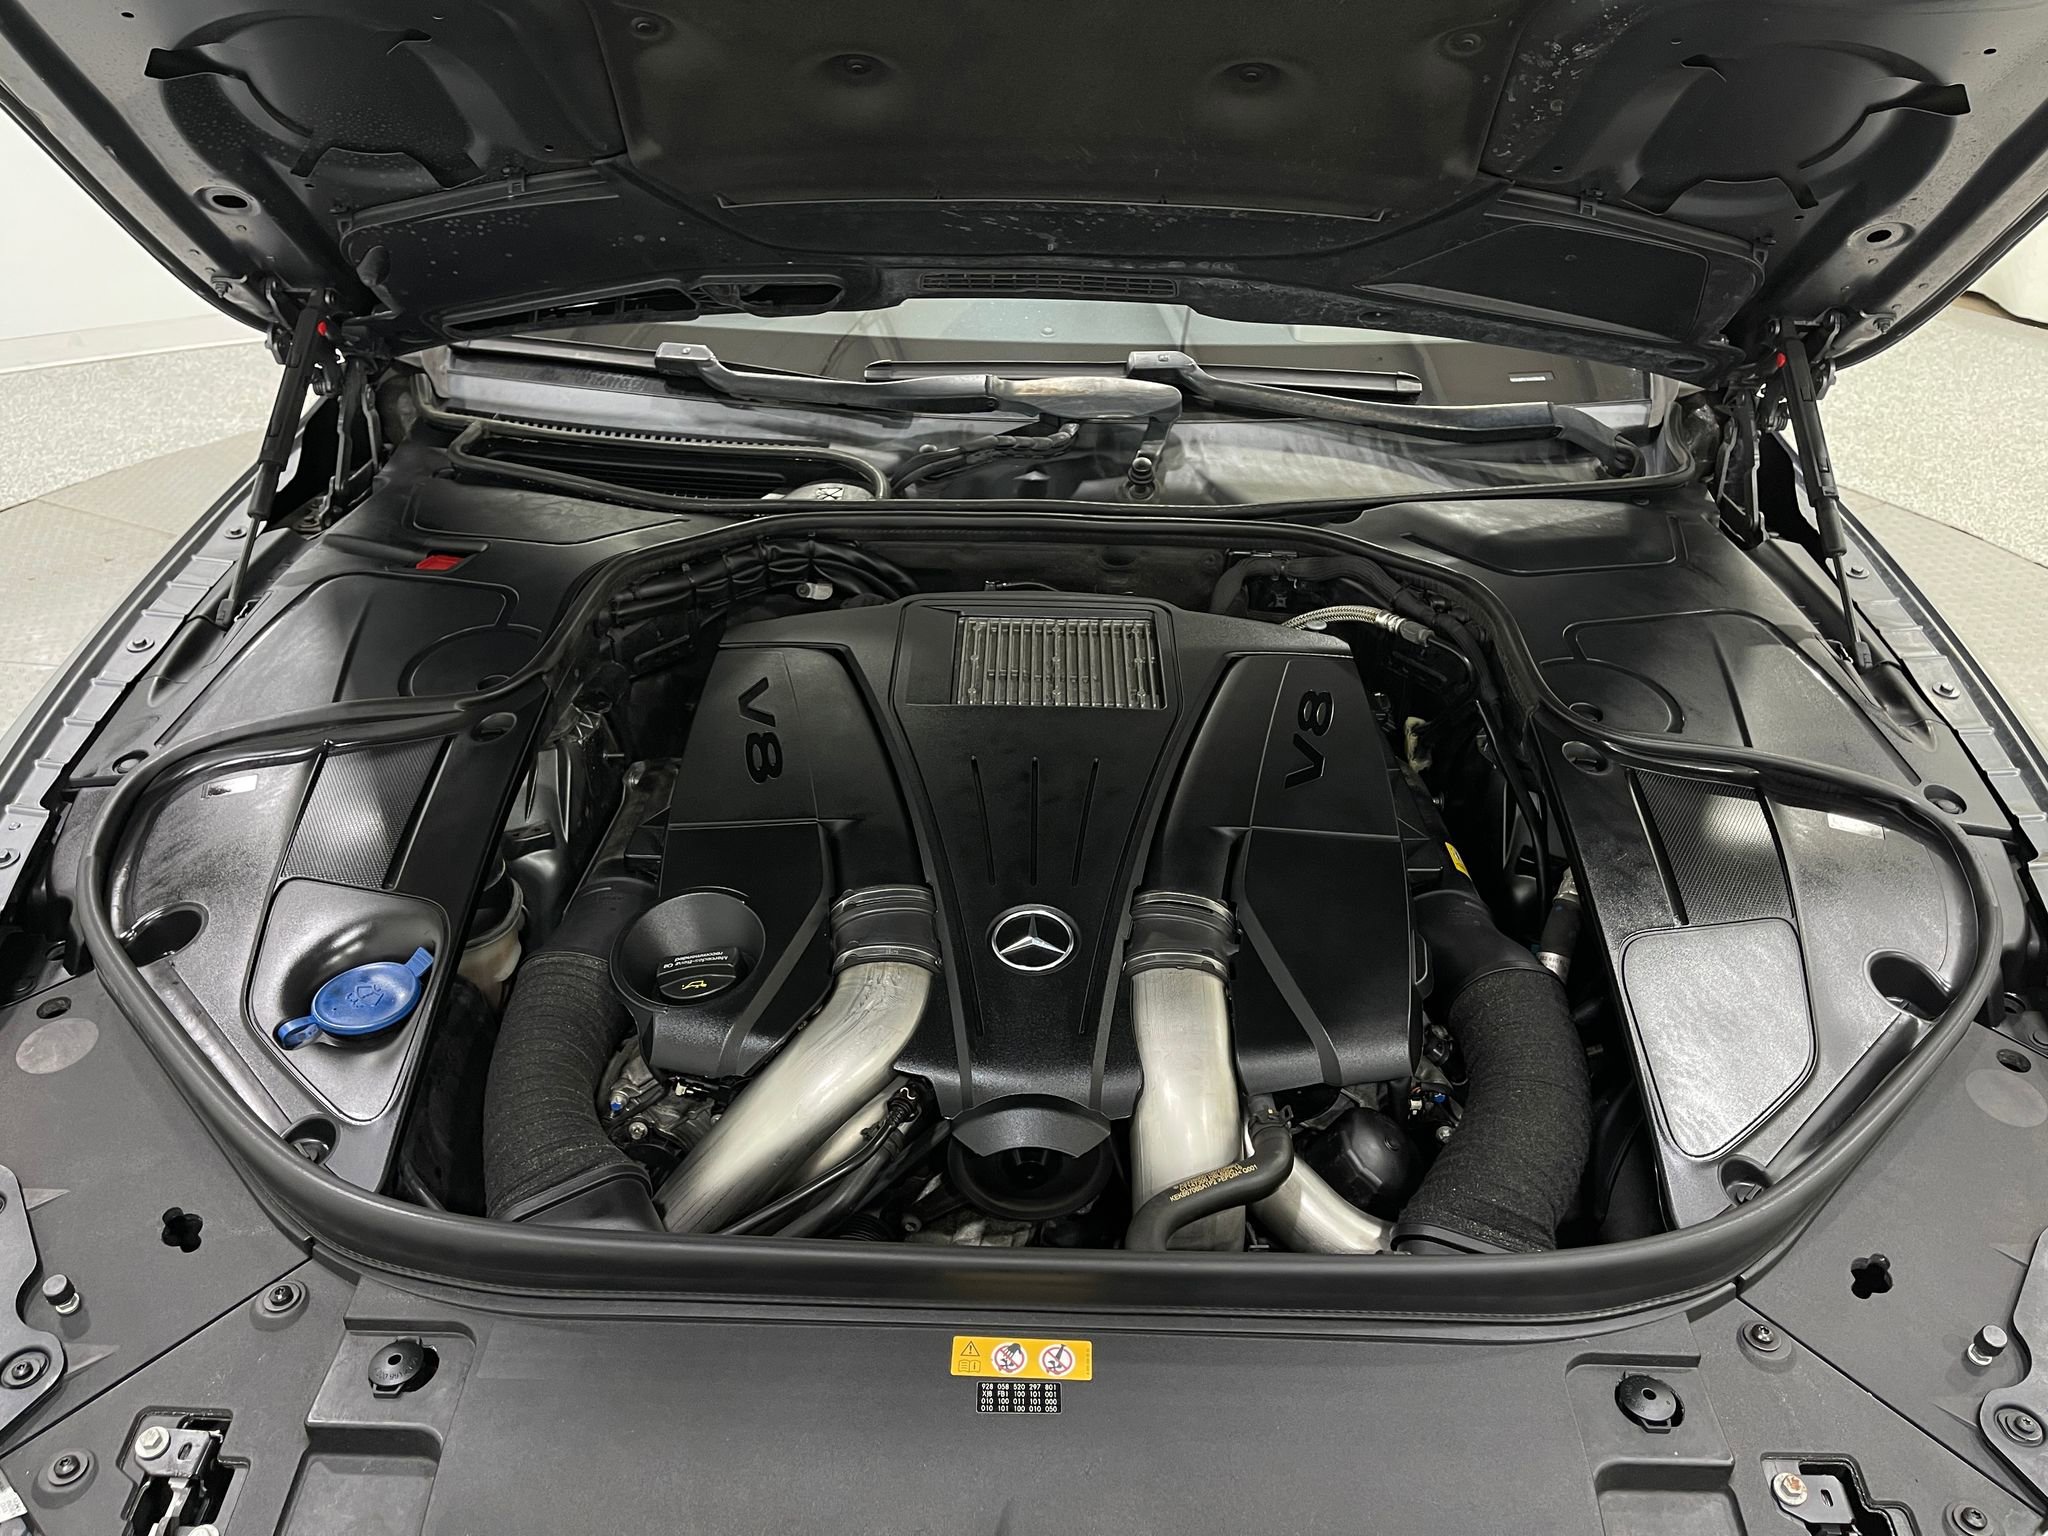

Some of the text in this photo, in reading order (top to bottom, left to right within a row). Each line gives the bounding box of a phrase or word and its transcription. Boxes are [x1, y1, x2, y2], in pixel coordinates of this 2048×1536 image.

[738, 676, 784, 785] V8
[1284, 689, 1335, 789] V8
[1013, 1390, 1026, 1398] 100
[1029, 1390, 1041, 1398] 101
[1044, 1390, 1057, 1398] 001
